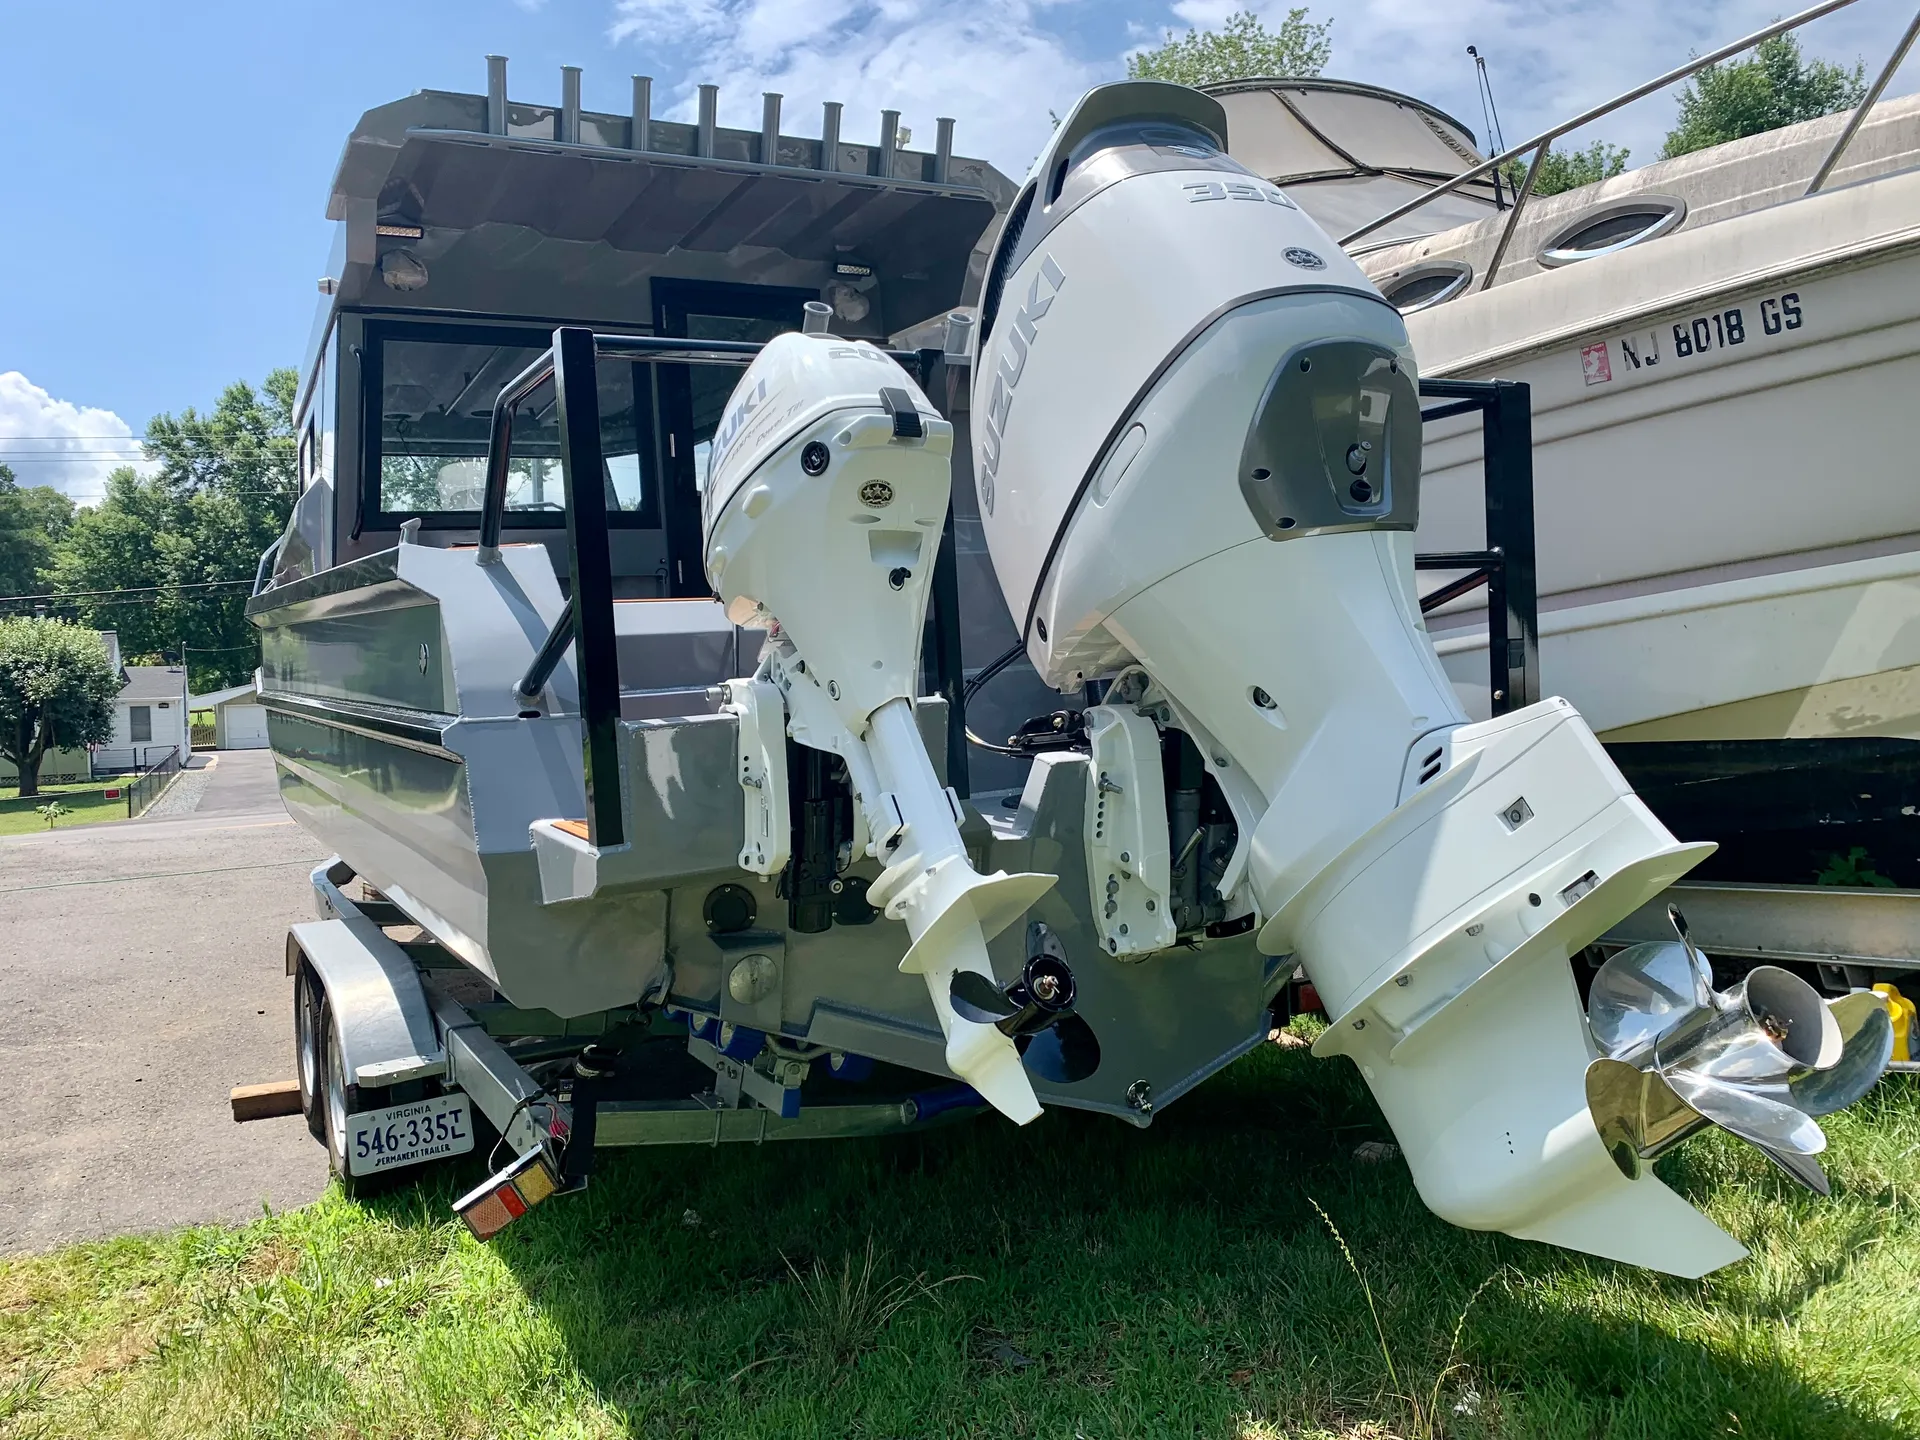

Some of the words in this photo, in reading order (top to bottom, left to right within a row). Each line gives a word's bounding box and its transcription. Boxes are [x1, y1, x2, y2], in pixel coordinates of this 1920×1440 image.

[1620, 331, 1661, 371] NJ
[1672, 308, 1746, 358] 8018
[1759, 292, 1803, 336] GS
[980, 252, 1066, 518] SUZUKI
[385, 1104, 432, 1121] VIRGINIA
[375, 1148, 420, 1167] PERMANENT
[420, 1143, 451, 1158] TRAILER
